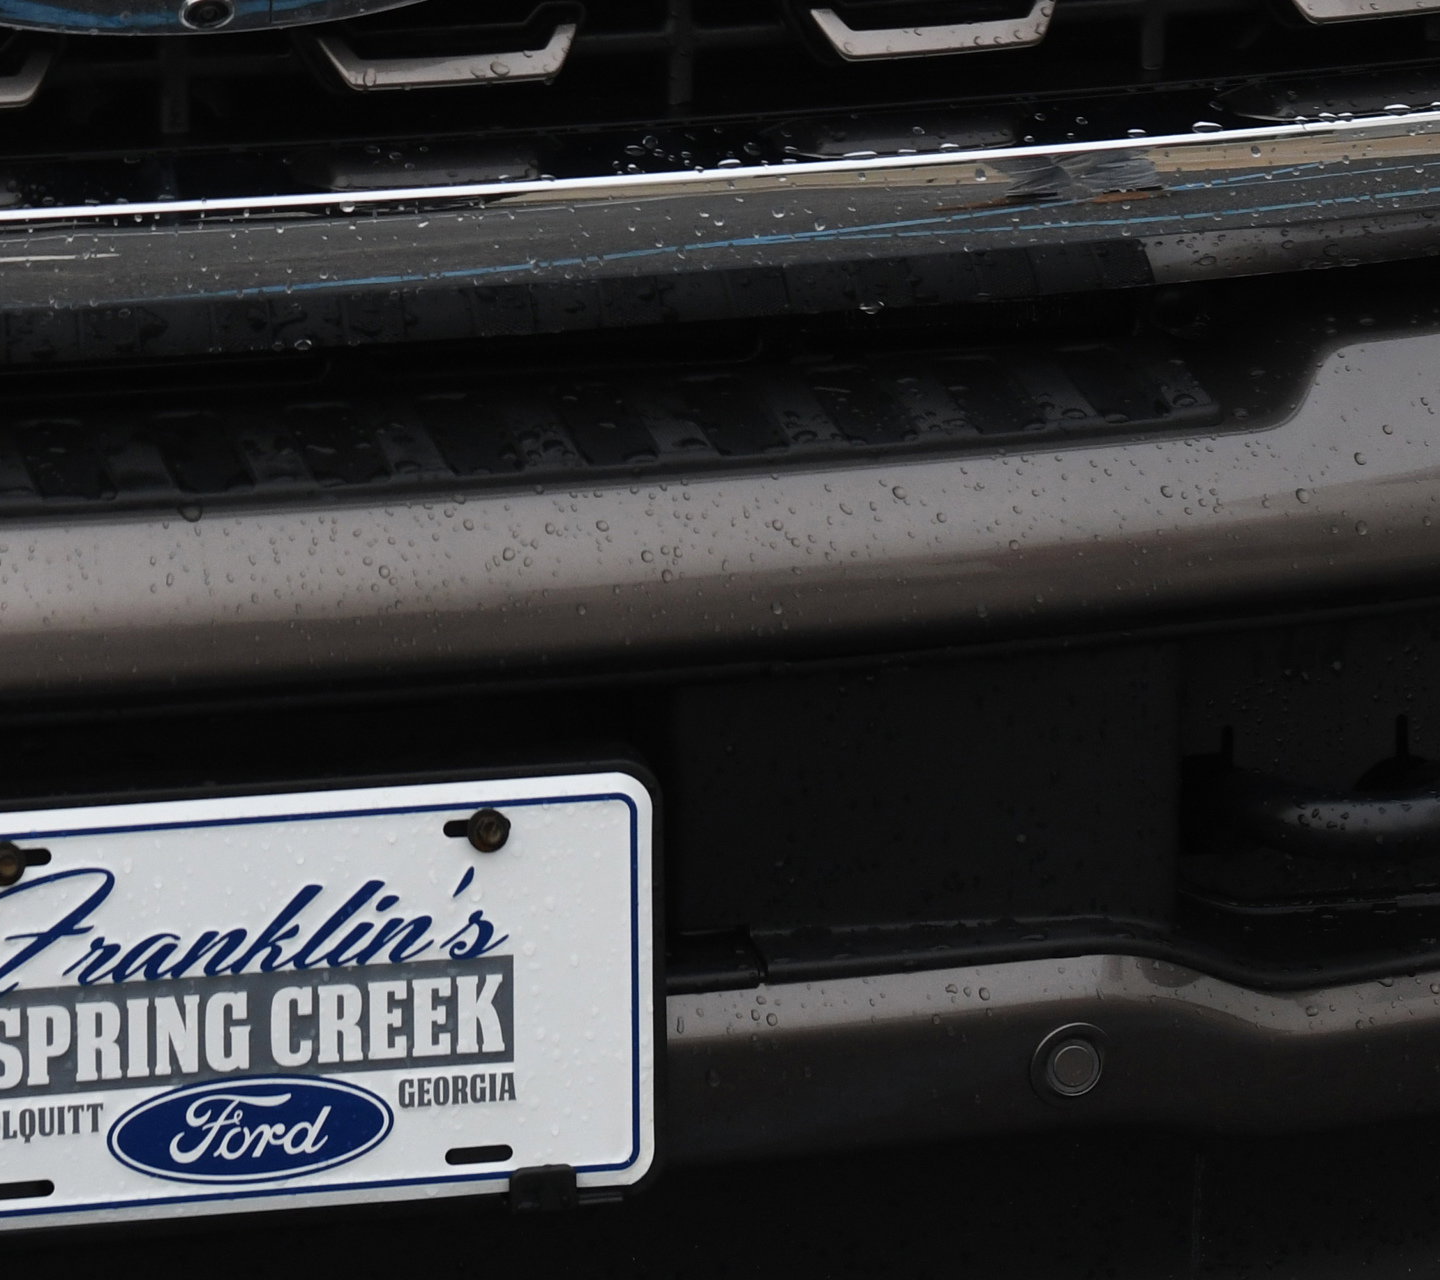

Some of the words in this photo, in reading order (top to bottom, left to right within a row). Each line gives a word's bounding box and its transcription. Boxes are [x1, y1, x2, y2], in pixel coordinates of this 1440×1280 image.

[269, 972, 506, 1069] CREEK
[397, 1071, 518, 1110] GEORGIA
[168, 1091, 328, 1164] Ford
